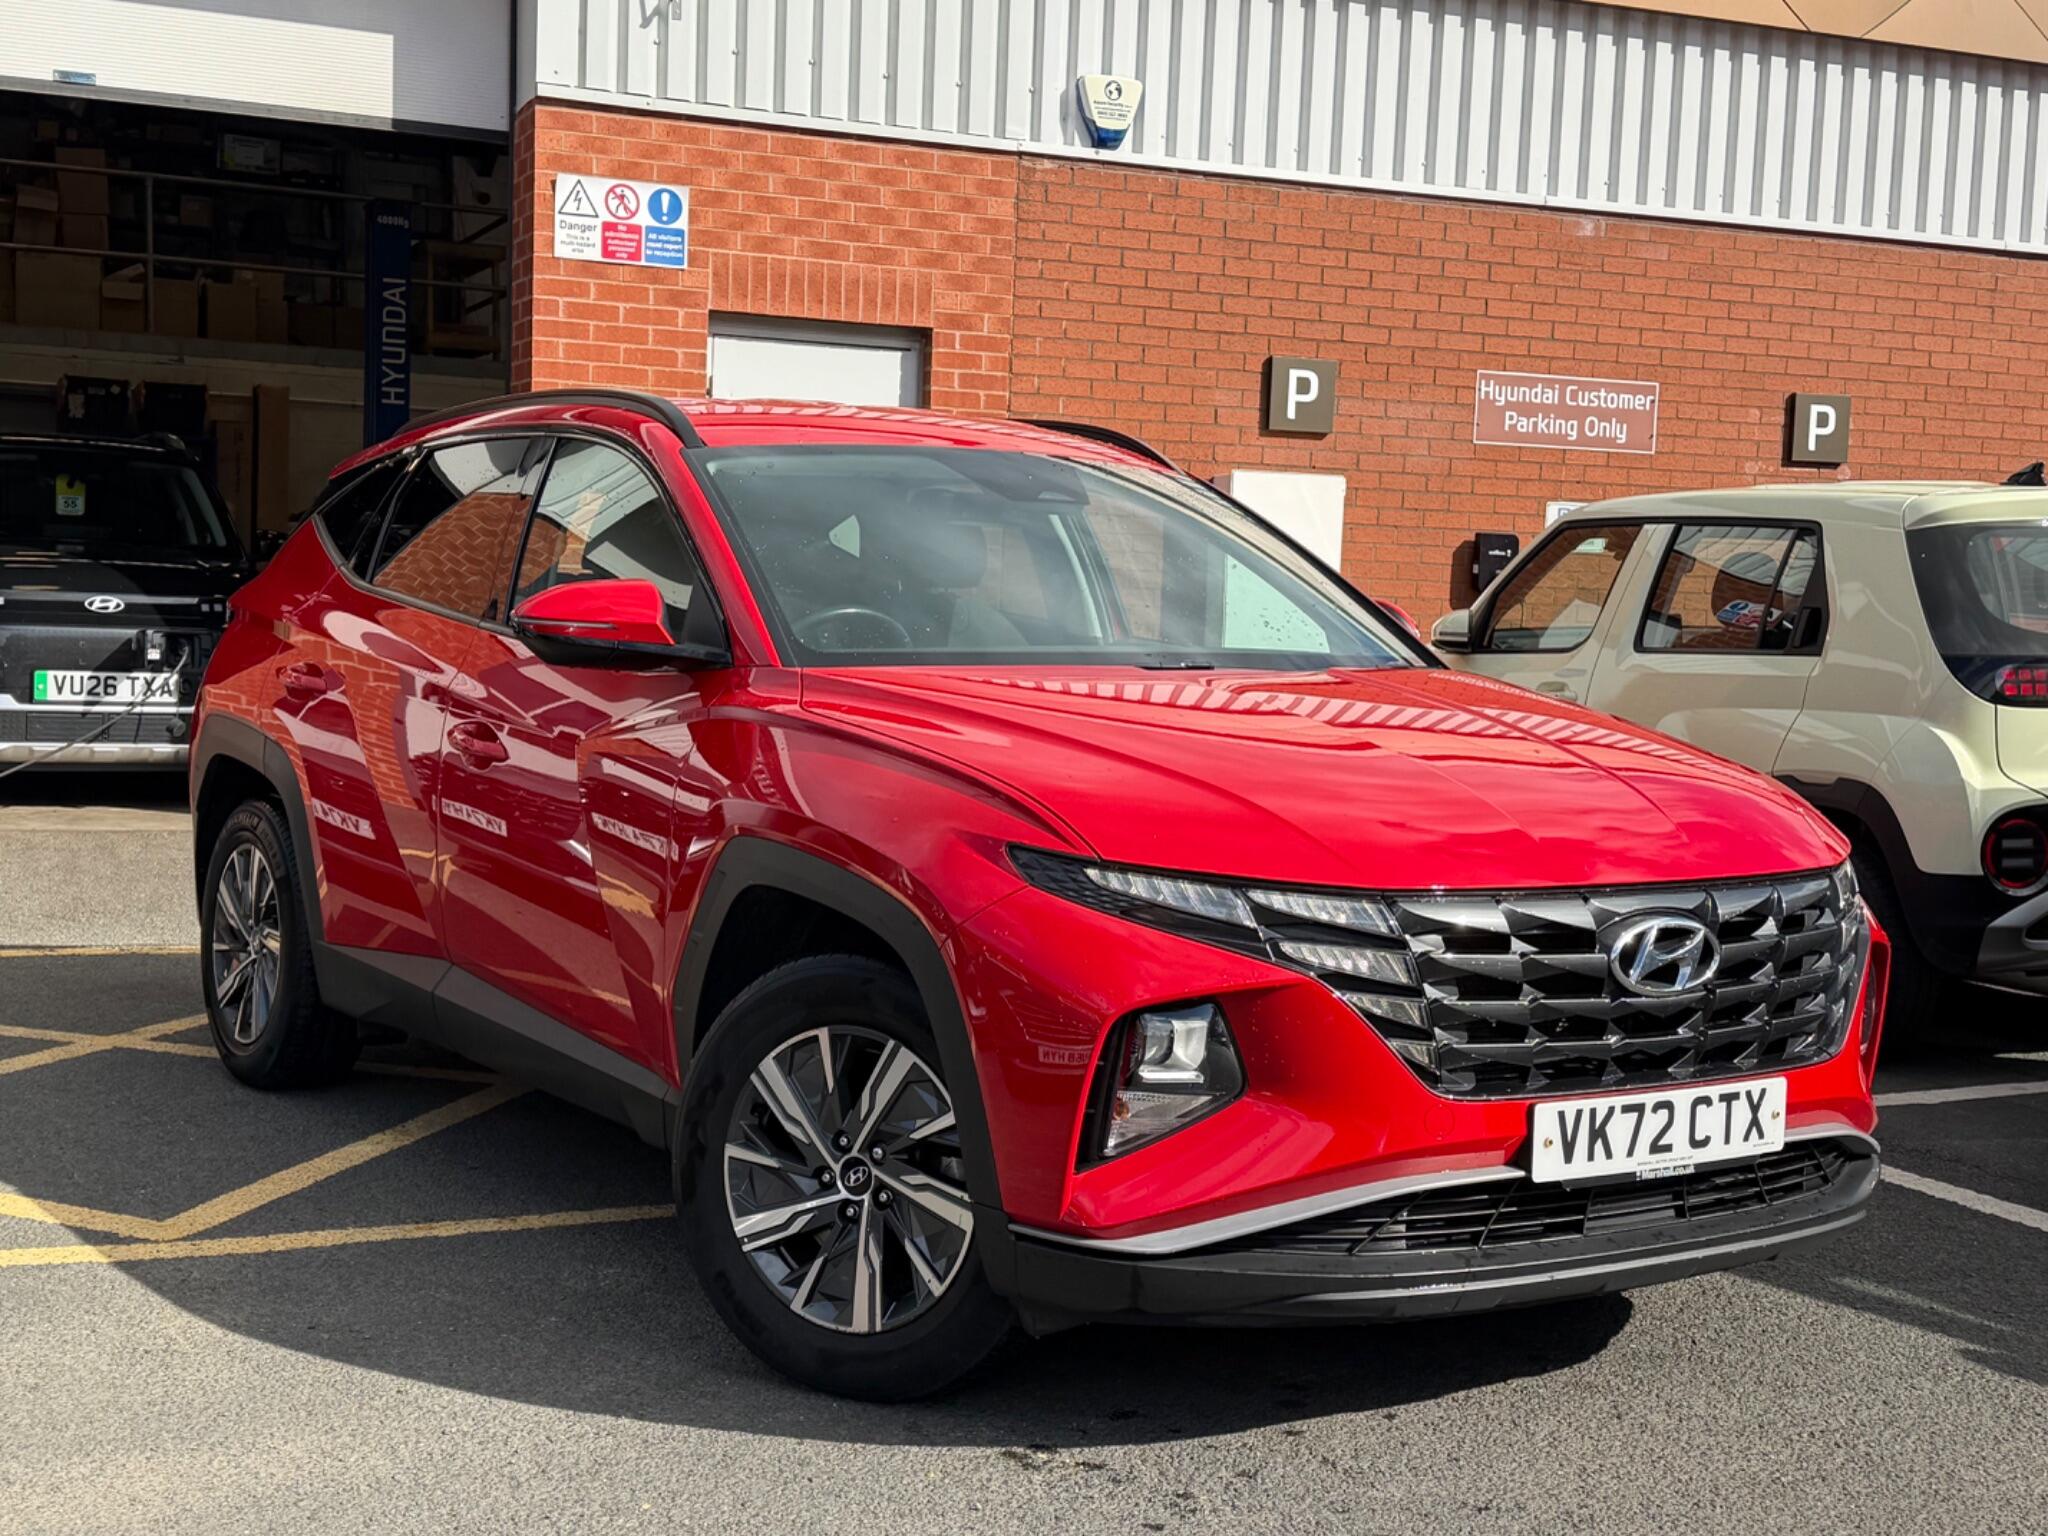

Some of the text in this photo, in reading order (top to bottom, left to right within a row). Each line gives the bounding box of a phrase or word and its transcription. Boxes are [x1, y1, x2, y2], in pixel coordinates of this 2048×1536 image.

[560, 220, 597, 233] Danger
[381, 277, 407, 405] HYUNDAI
[1286, 368, 1319, 420] P
[1480, 379, 1656, 411] Hyundai Customer
[1504, 411, 1628, 444] Parking Only
[1808, 403, 1836, 451] P
[53, 674, 174, 698] VU26 TXA
[1557, 1087, 1767, 1165] VK72 CTX
